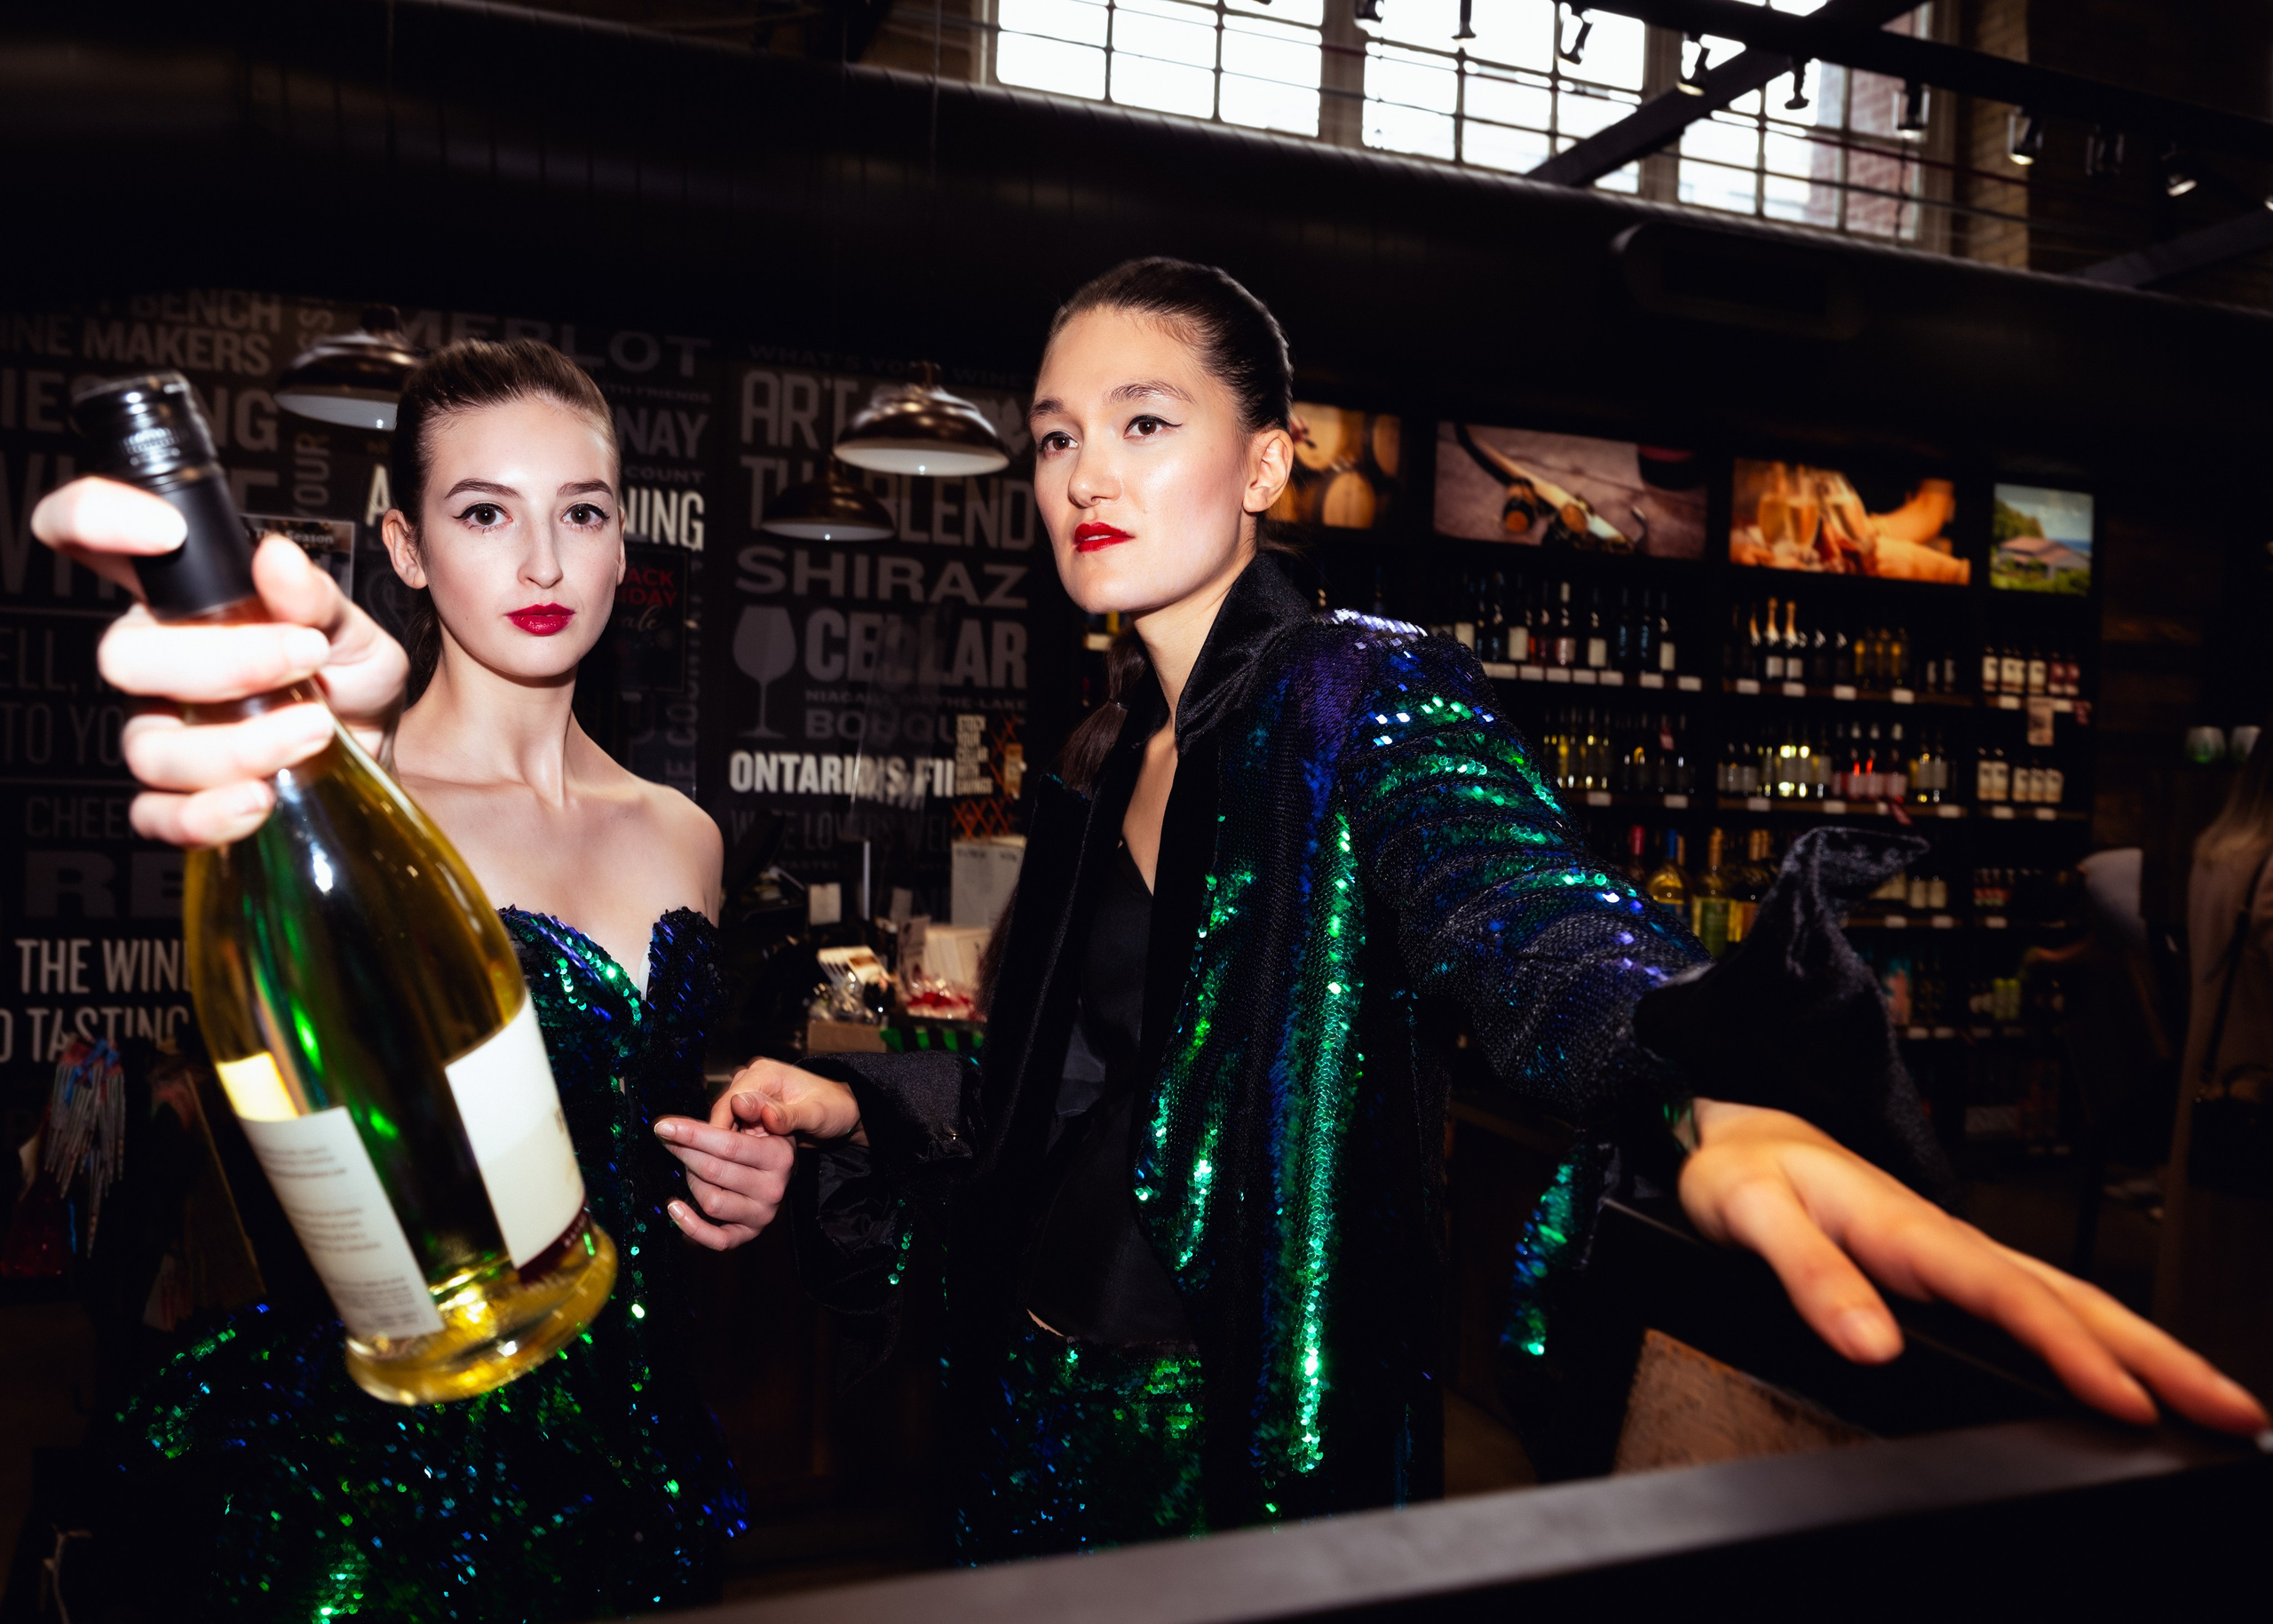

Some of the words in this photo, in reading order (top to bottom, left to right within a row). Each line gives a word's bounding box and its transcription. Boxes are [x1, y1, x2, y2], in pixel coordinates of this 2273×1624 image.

[0, 312, 73, 358] INE
[82, 316, 273, 377] MAKERS
[636, 385, 712, 404] FRIENDS
[614, 404, 710, 460] NAY
[626, 567, 677, 590] ACK
[734, 544, 1030, 609] SHIRAZ
[804, 606, 1028, 691] CELLAR
[804, 707, 956, 745] BOUQU
[13, 937, 93, 995] THE
